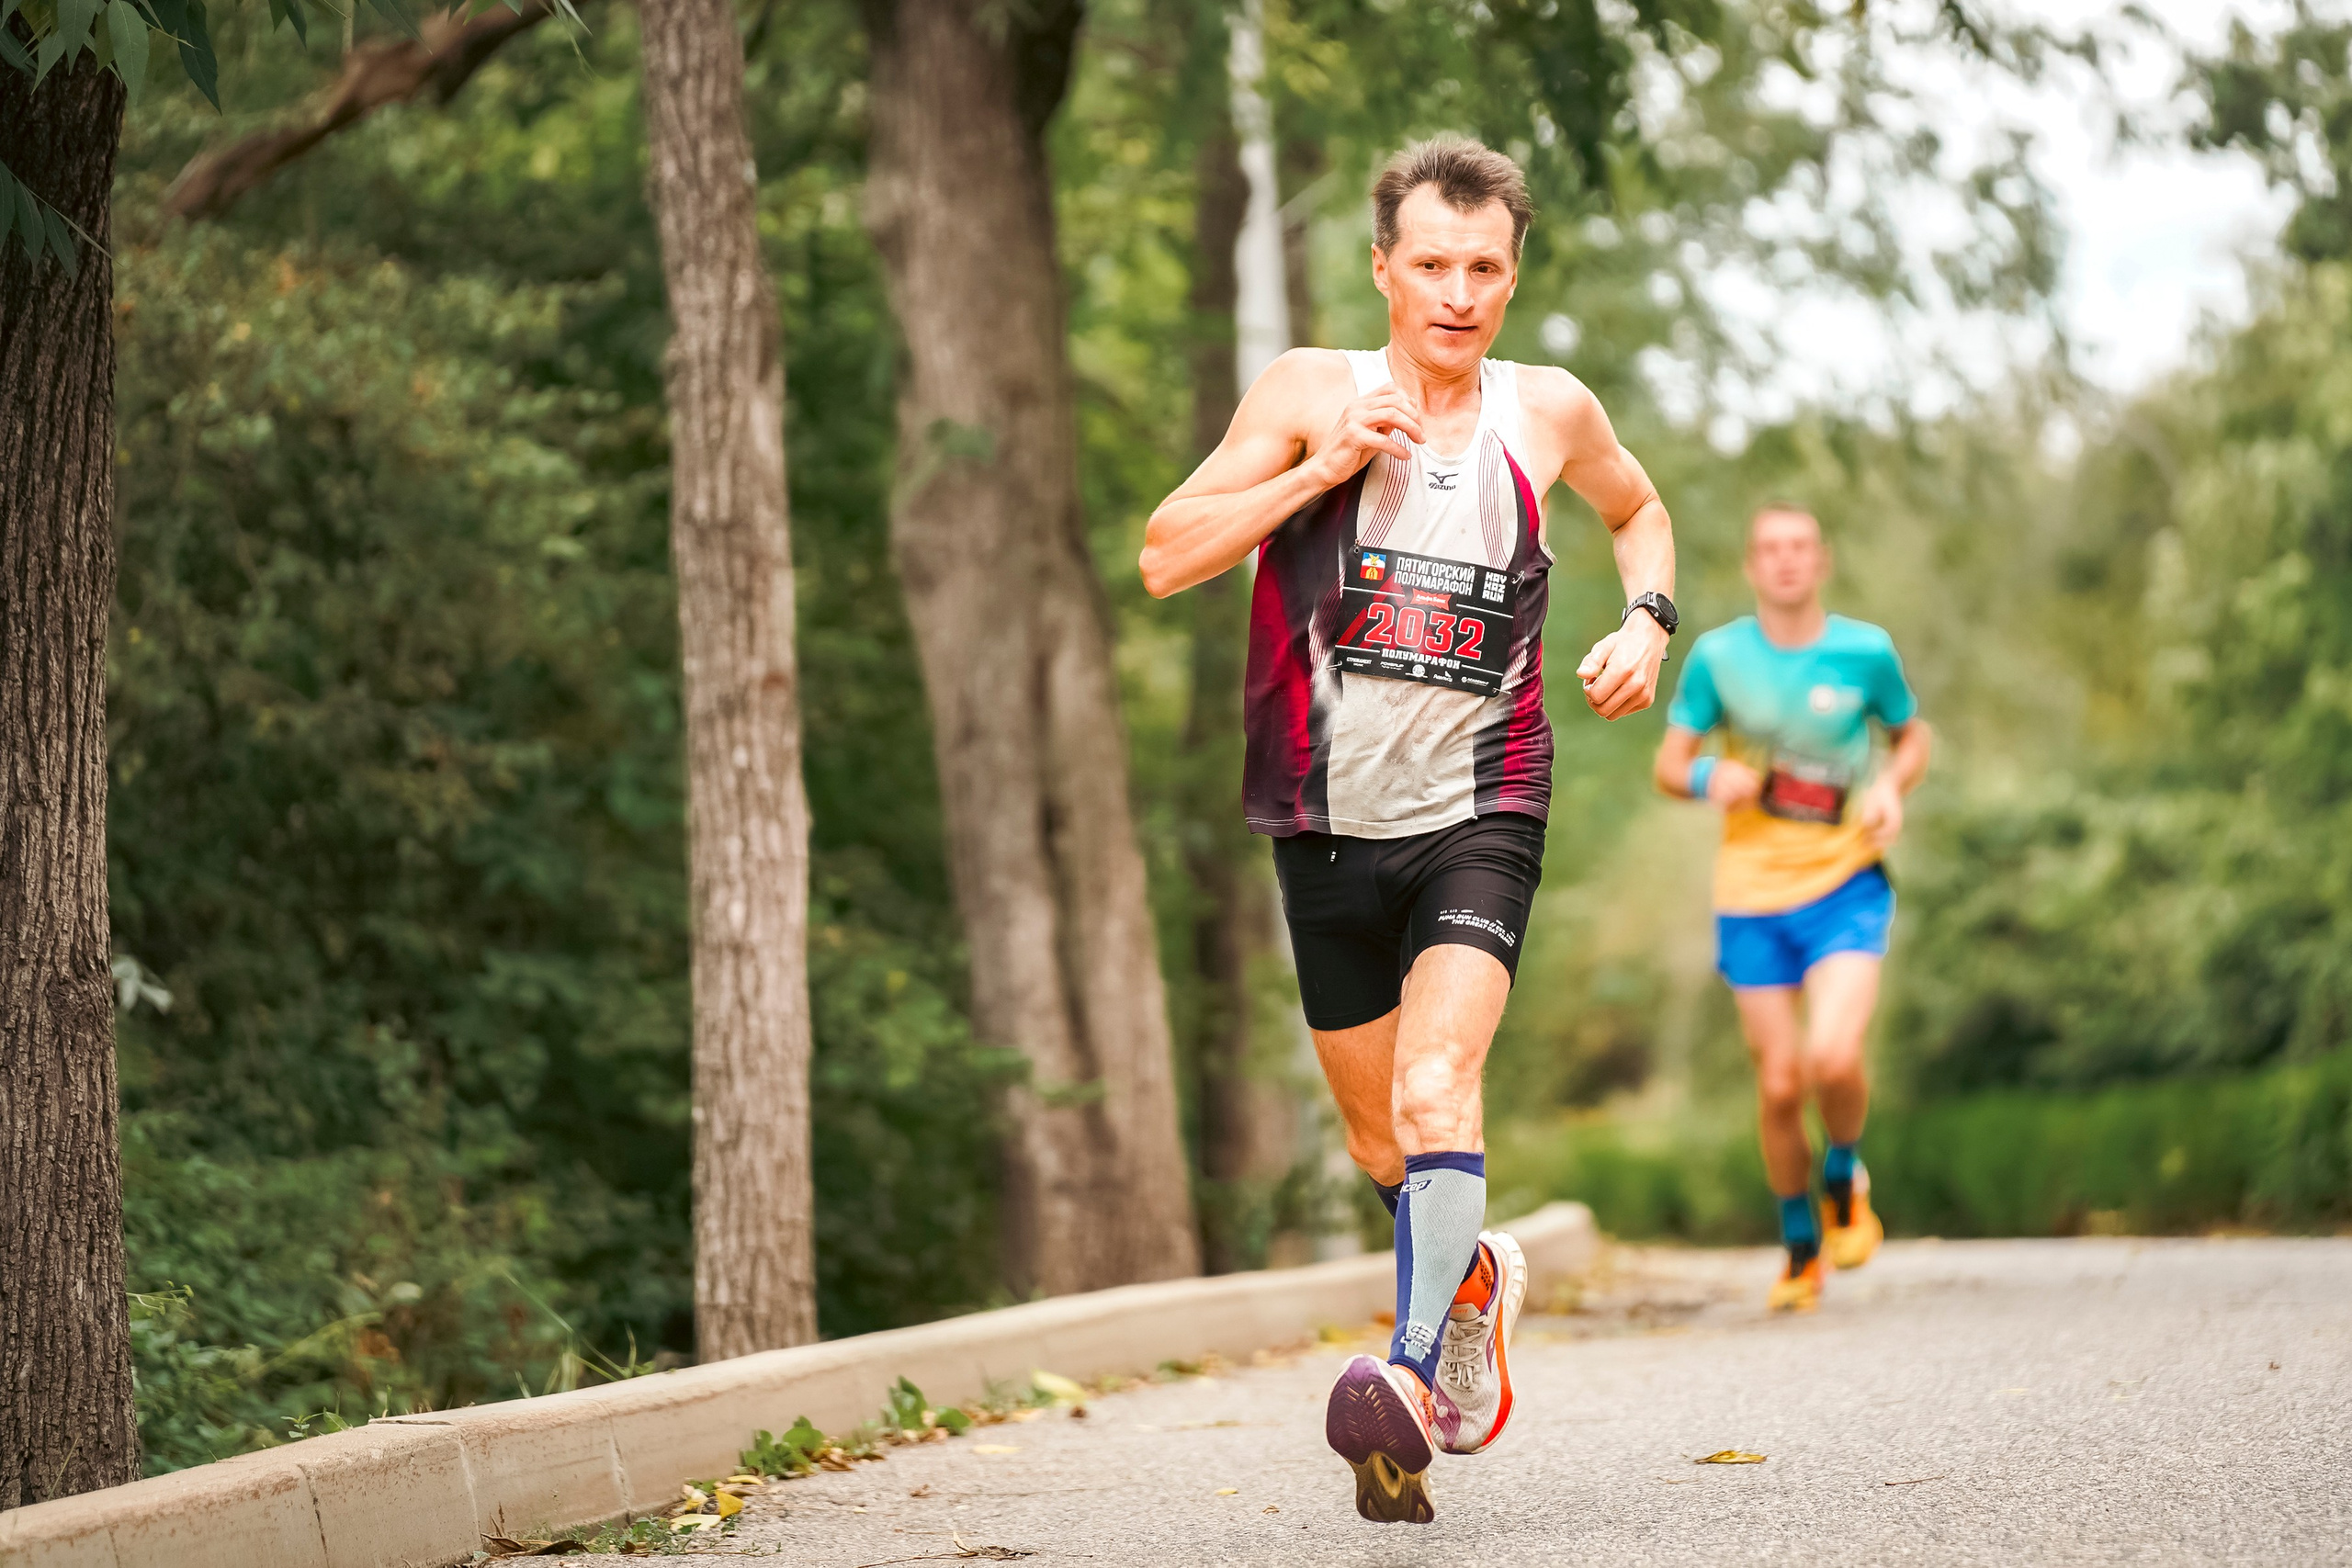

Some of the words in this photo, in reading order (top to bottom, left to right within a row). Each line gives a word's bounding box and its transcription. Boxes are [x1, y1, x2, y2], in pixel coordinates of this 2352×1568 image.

[1396, 556, 1476, 582] ПЯТИГОРСКИЙ
[1394, 570, 1474, 596] ПОЛУМАРАФОН
[1481, 589, 1505, 604] RUN
[1364, 602, 1486, 660] 2032
[1381, 648, 1463, 670] ПОЛУМАРАФОН
[1437, 914, 1455, 922] PUMA
[1472, 916, 1490, 925] CLUB
[1464, 919, 1487, 930] GREAT
[1487, 926, 1498, 935] CAT
